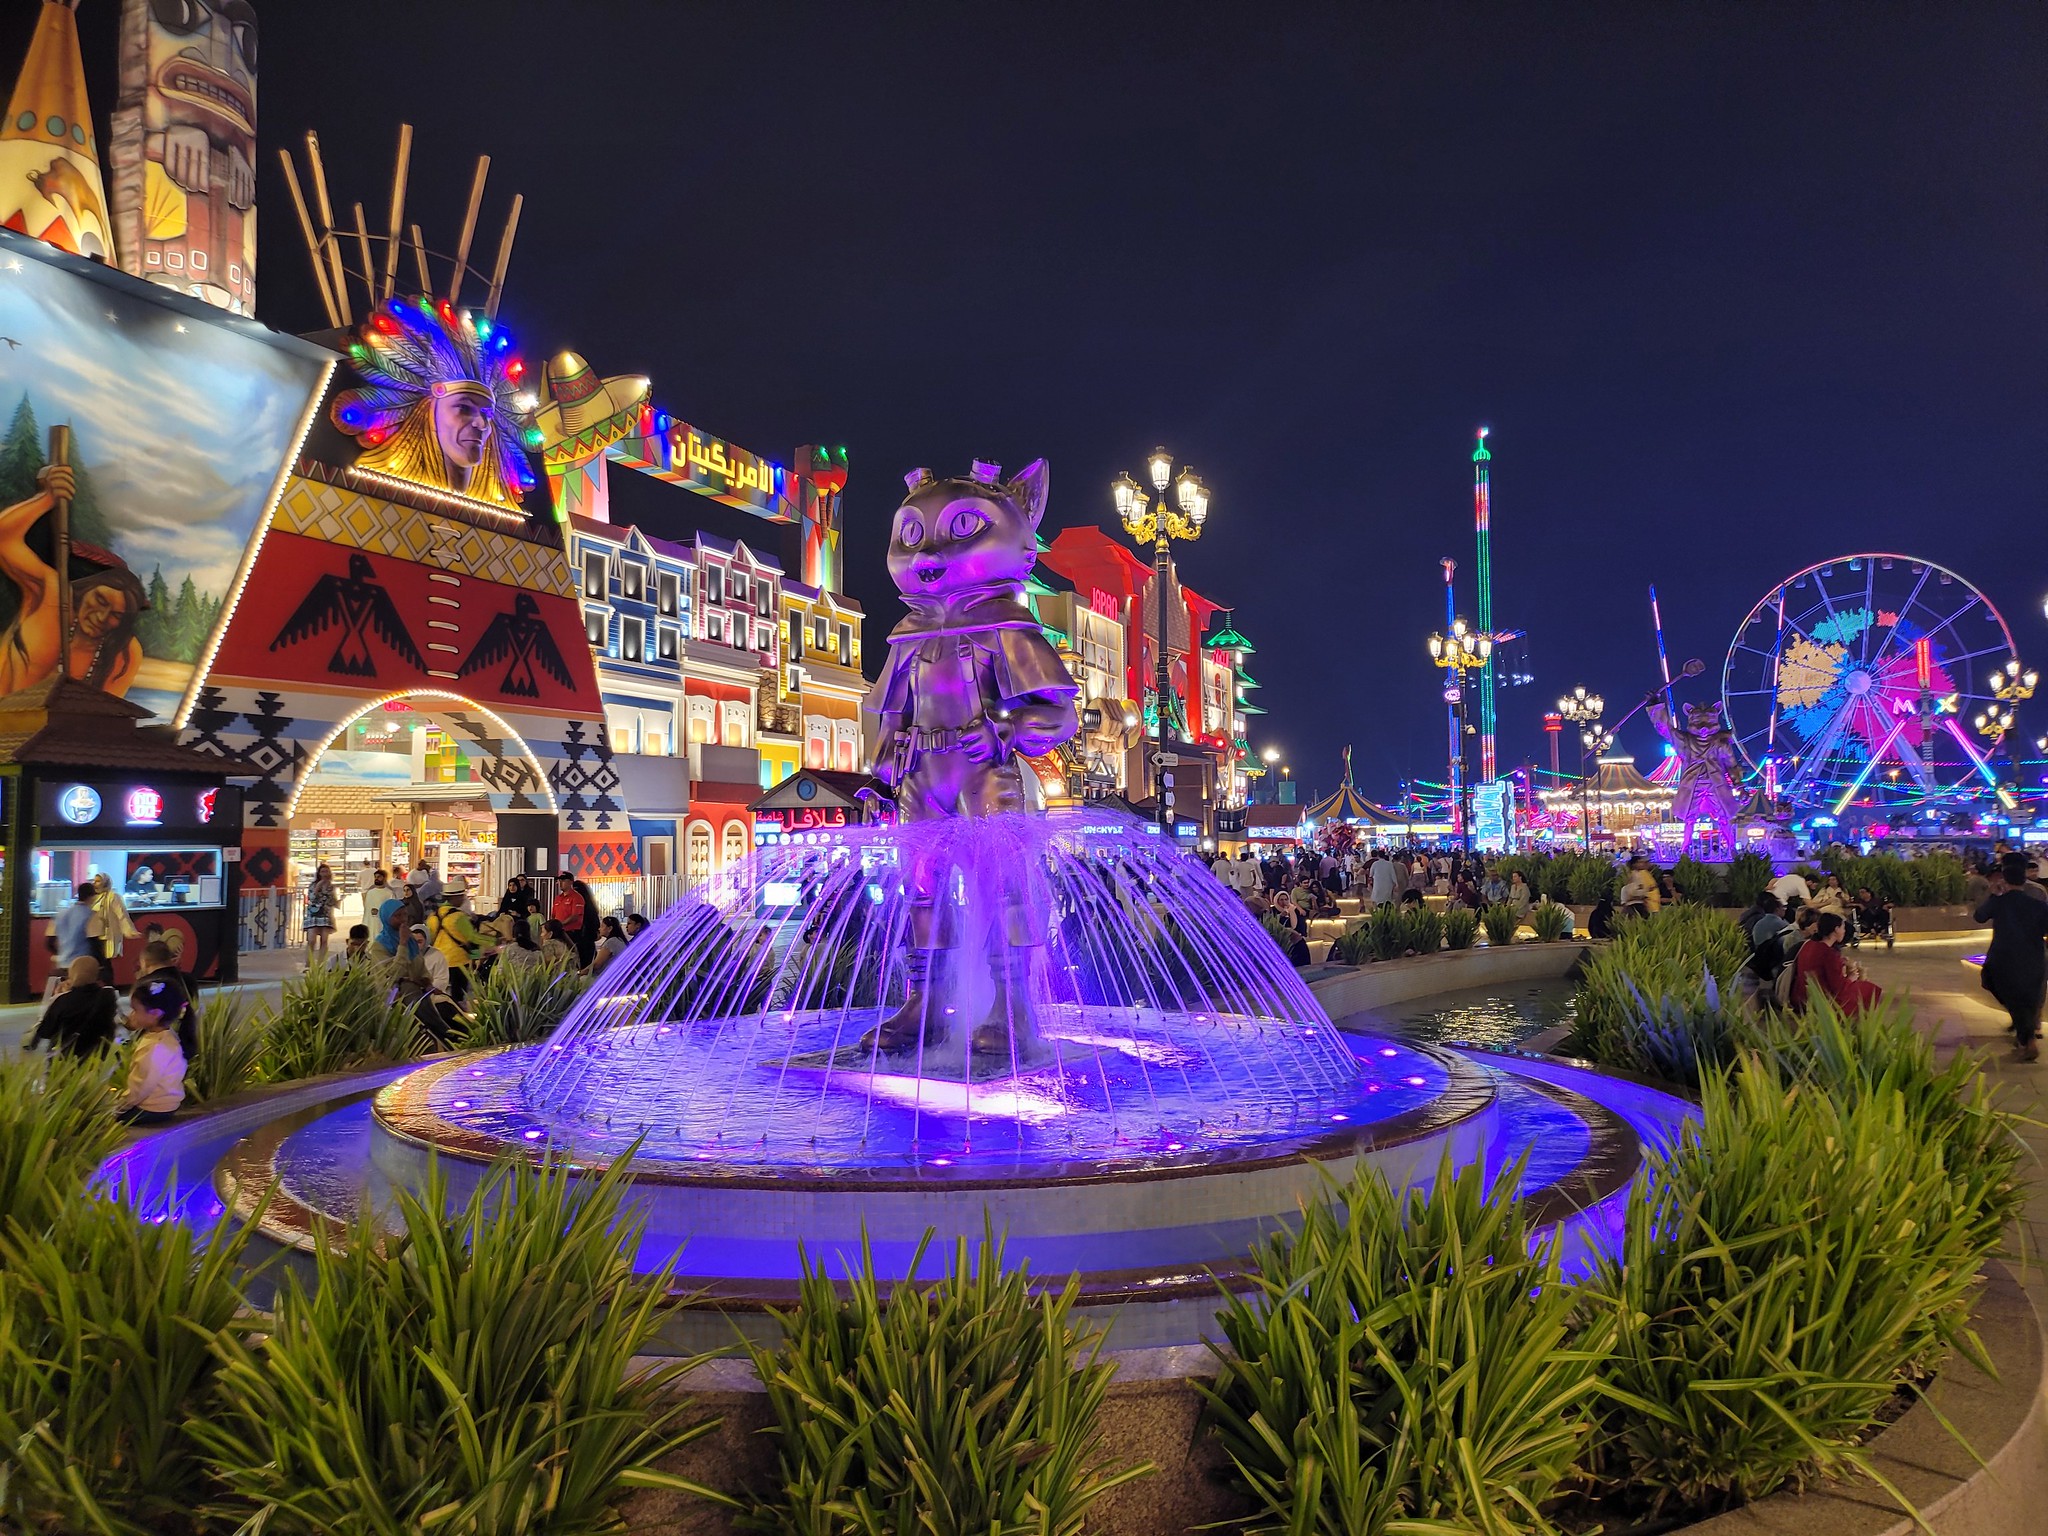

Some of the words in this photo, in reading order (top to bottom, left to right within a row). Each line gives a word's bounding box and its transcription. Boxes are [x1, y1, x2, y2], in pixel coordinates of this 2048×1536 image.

[671, 432, 774, 495] الأمريكيتان
[1090, 587, 1118, 621] JAPAN
[781, 807, 846, 833] فلافل
